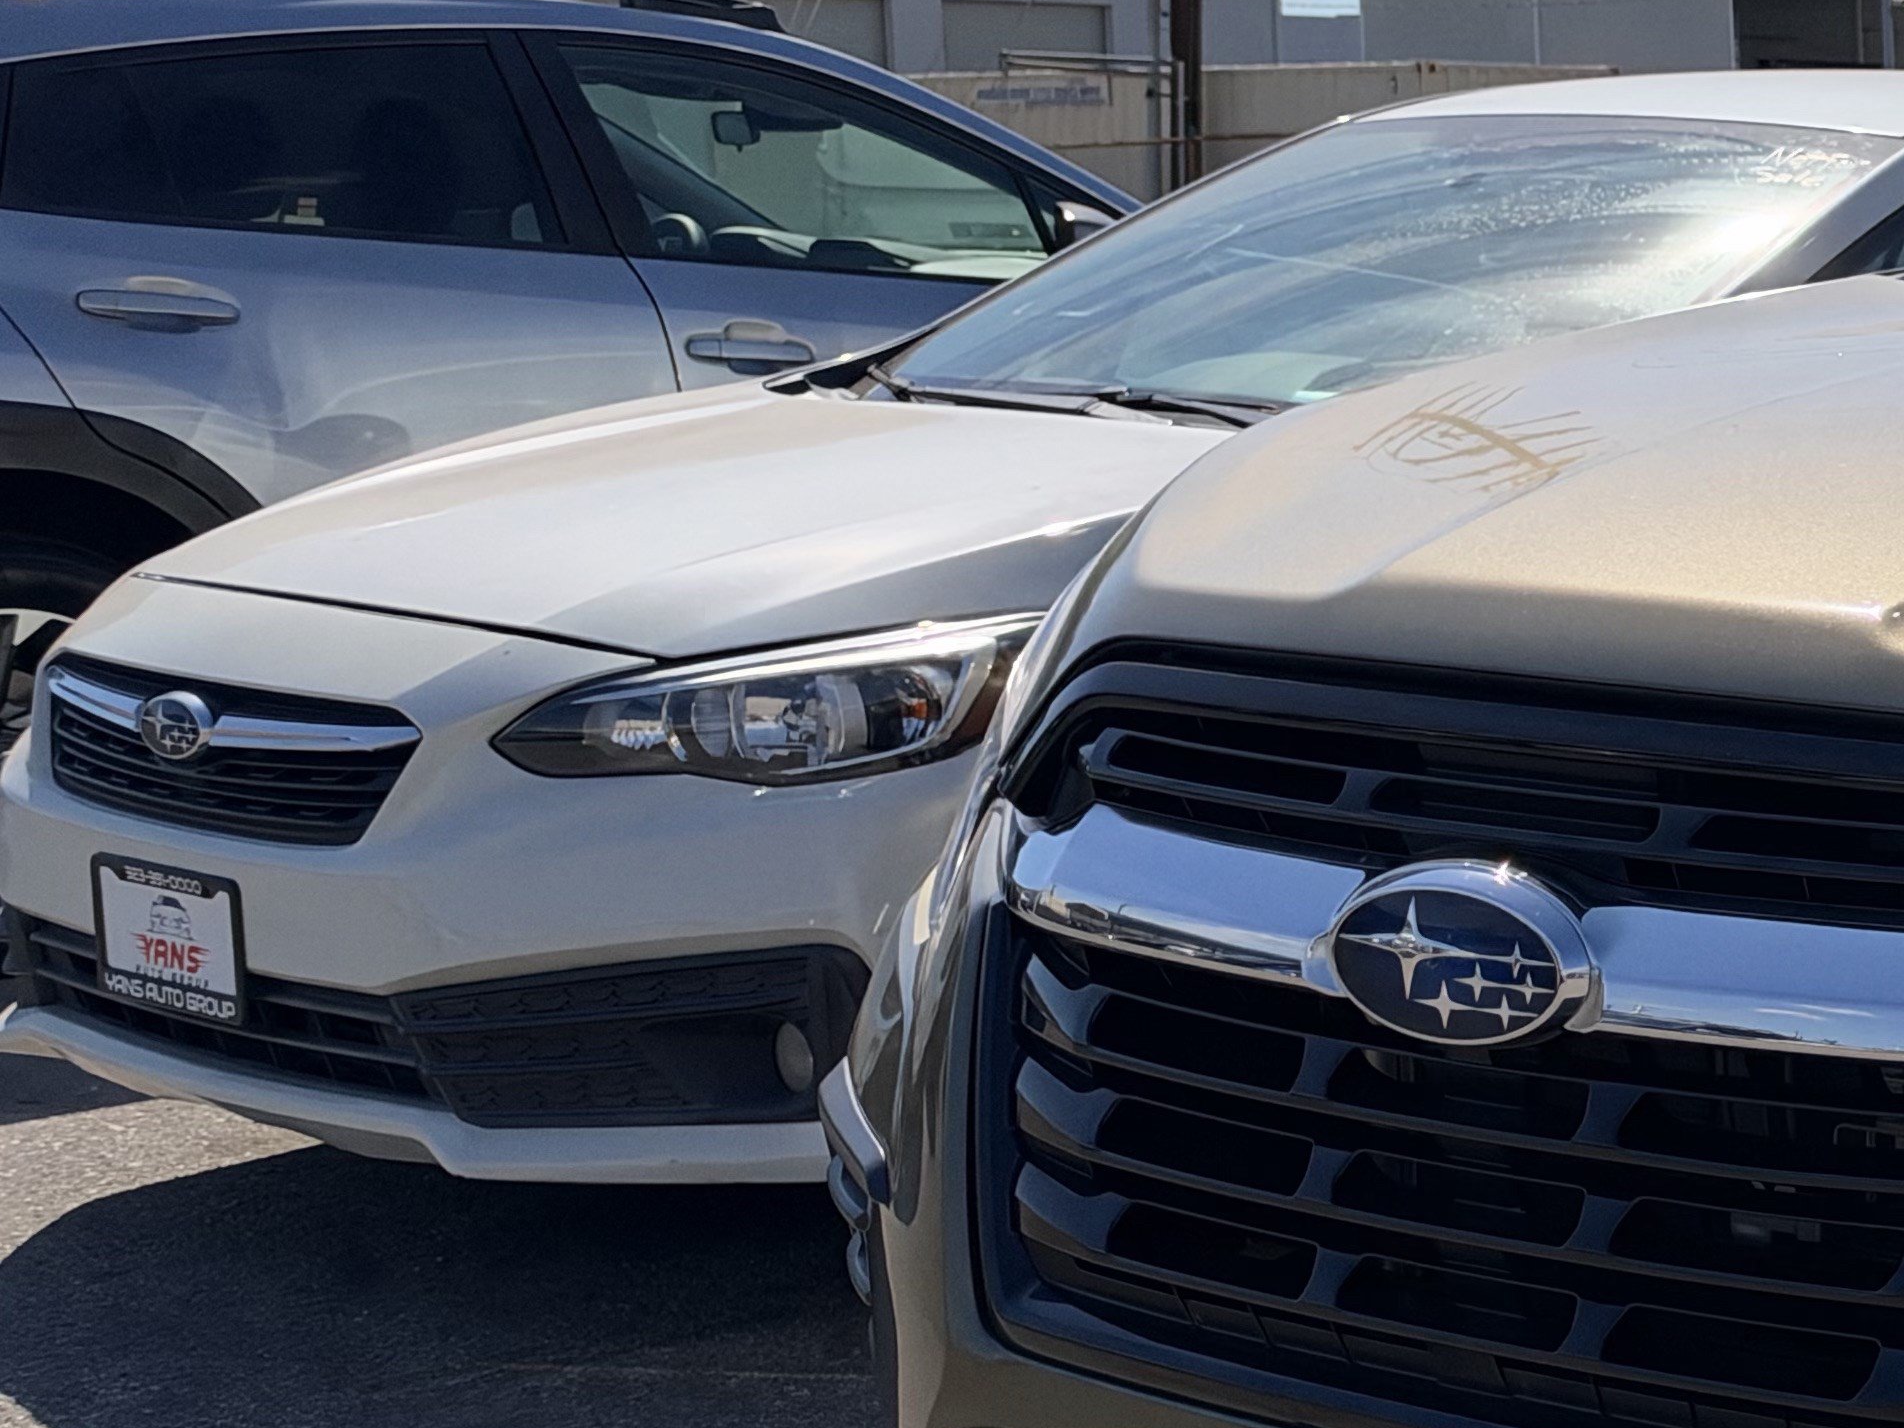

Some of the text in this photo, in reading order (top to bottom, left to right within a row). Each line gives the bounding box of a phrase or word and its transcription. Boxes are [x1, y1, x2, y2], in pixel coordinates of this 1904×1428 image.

[134, 933, 211, 973] YANS
[104, 972, 236, 1019] YANS AUTO GROUP
